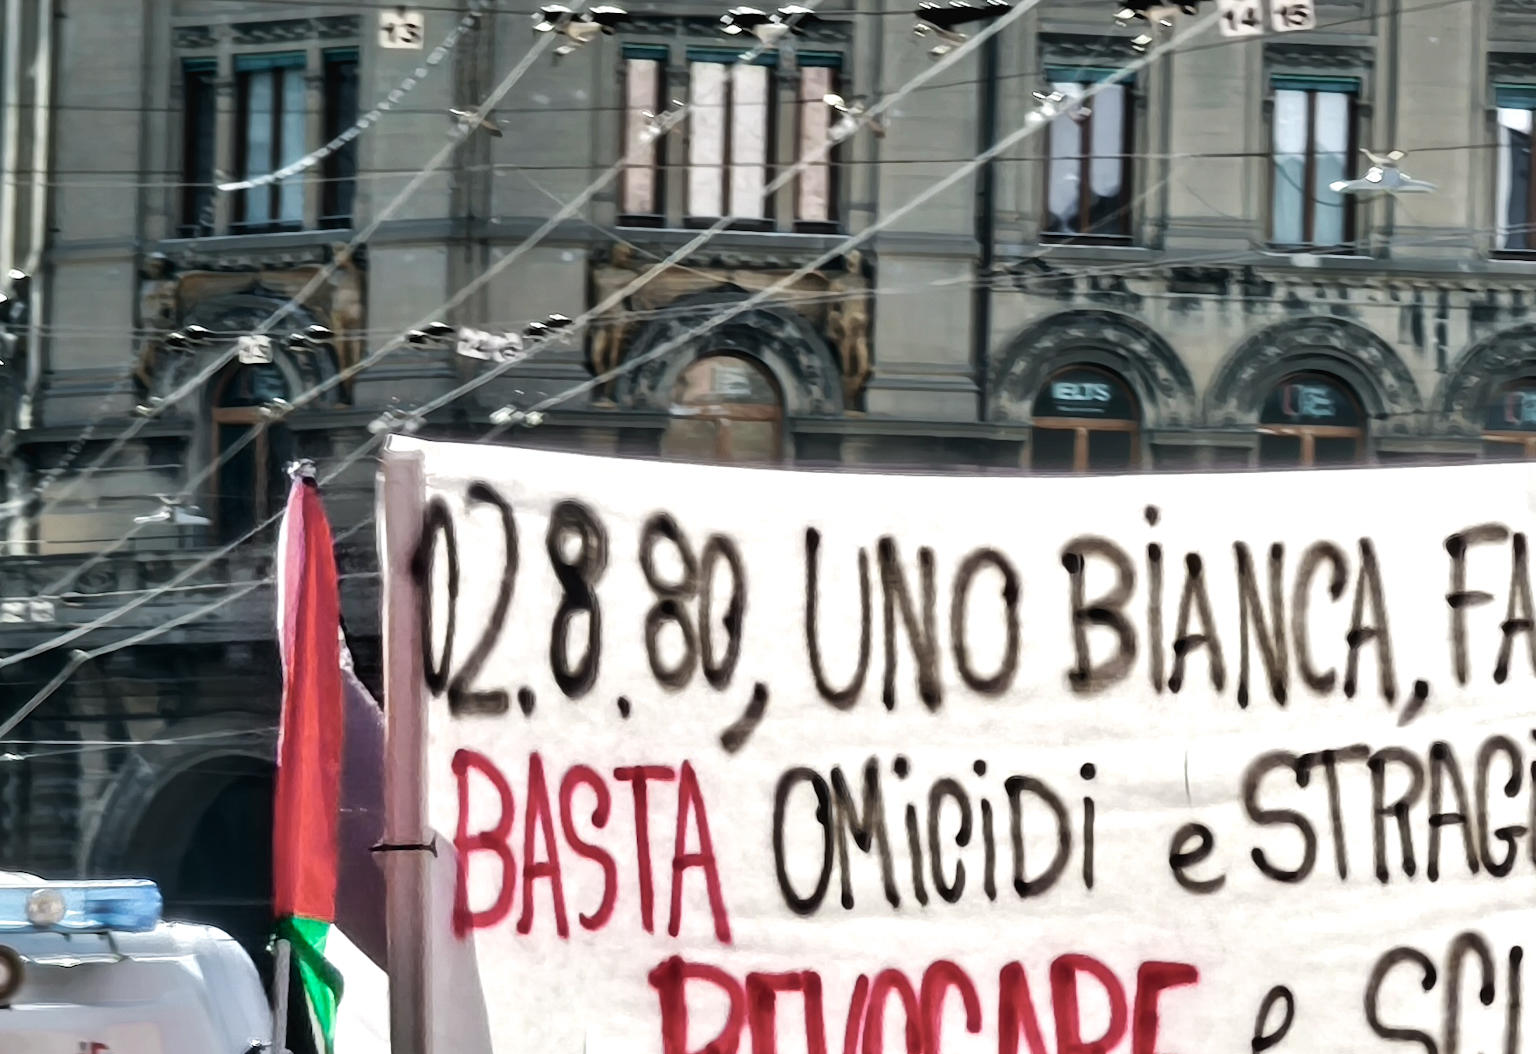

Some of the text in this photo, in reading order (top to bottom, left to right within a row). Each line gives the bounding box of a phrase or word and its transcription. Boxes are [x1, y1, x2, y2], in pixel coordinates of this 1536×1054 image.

[1222, 8, 1259, 31] 14
[1273, 4, 1307, 27] 15
[381, 23, 420, 43] 13
[1051, 382, 1111, 402] IELTS
[805, 527, 1021, 712] UNO
[451, 748, 732, 943] BASTA
[1170, 821, 1227, 893] e
